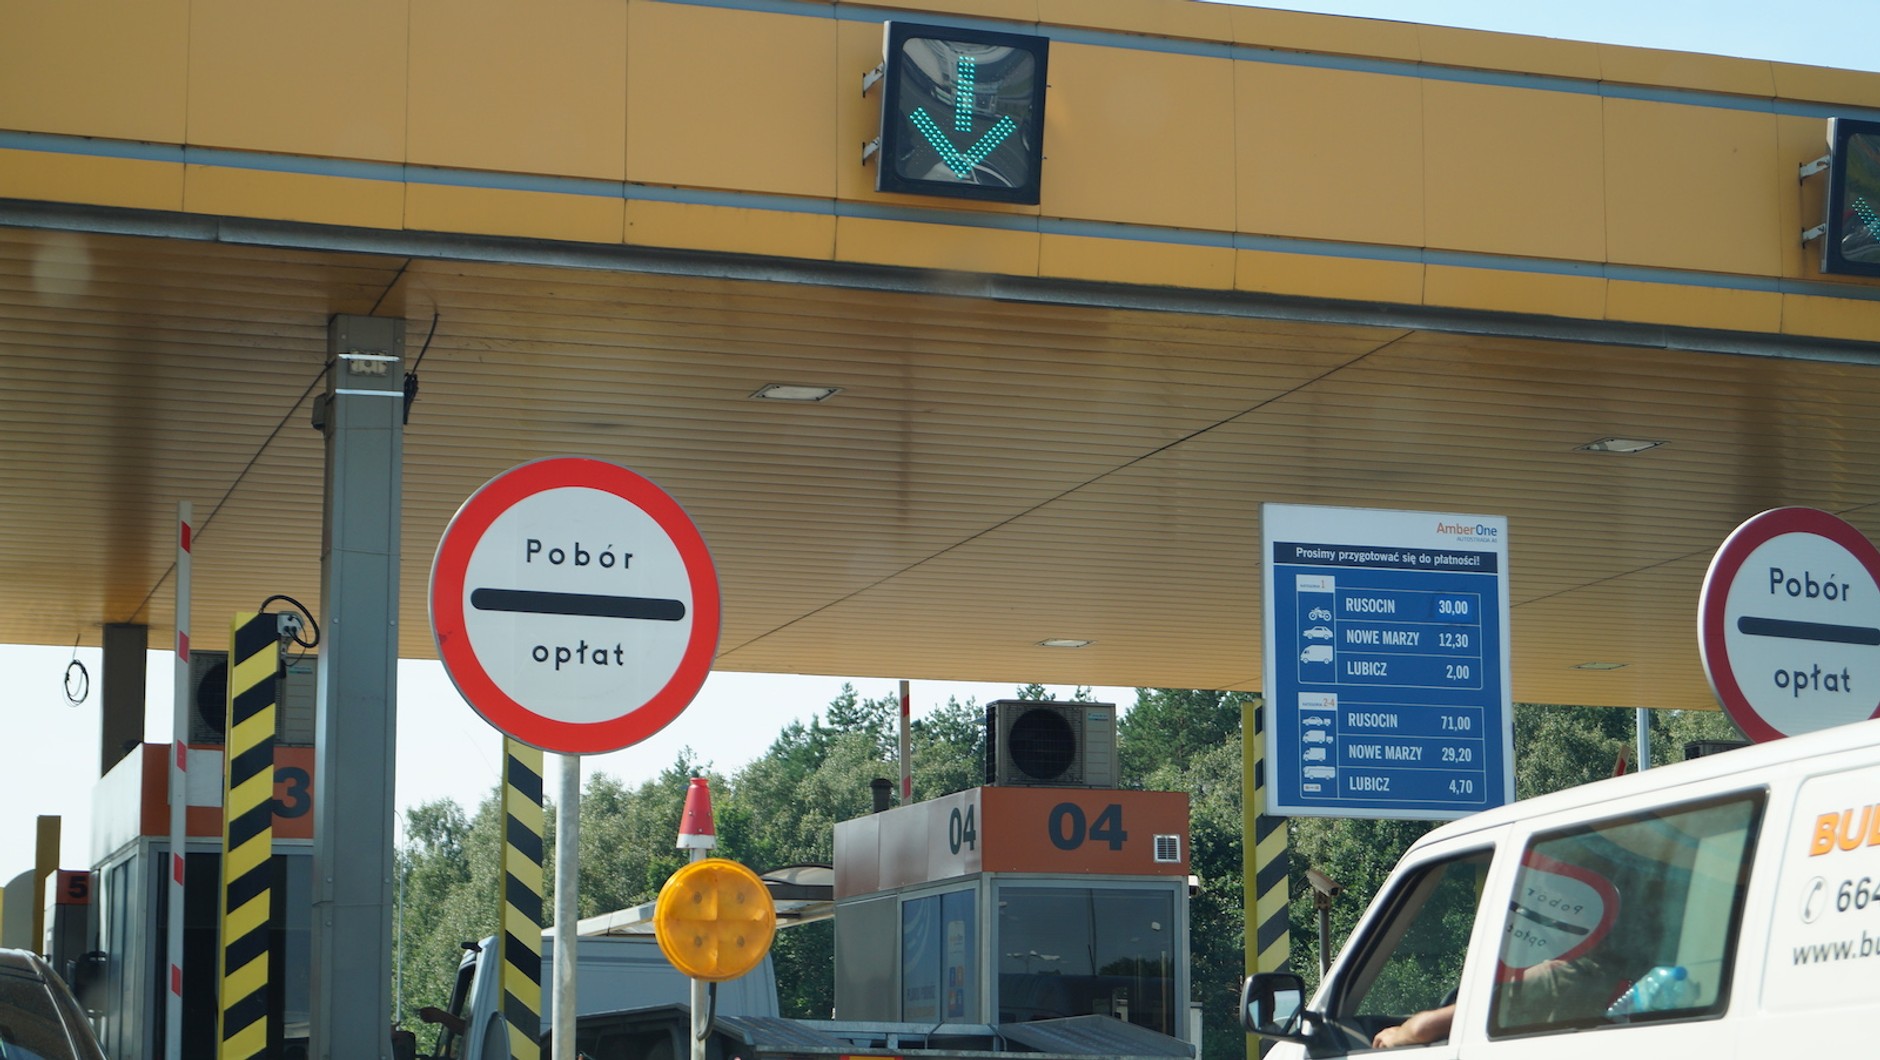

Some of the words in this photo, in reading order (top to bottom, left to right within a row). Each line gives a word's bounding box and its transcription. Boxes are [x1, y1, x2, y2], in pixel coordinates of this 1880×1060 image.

[1436, 521, 1498, 537] AmberOne
[526, 538, 633, 569] Pobór
[1296, 547, 1335, 561] Prosimy
[1338, 549, 1399, 563] przygotować
[1402, 552, 1416, 565] się
[1419, 553, 1431, 564] do
[1434, 553, 1481, 566] płatności!
[1769, 566, 1850, 602] Pobór
[1345, 597, 1396, 614] RUSOCIN
[1438, 599, 1468, 615] 30,00
[1346, 629, 1380, 645] NOWE
[1382, 631, 1420, 647] MARZY
[1438, 633, 1469, 649] 12,30
[531, 640, 624, 671] opłat
[1347, 661, 1388, 677] LUBICZ
[1446, 665, 1470, 681] 2,00
[1773, 663, 1851, 698] opłat
[1348, 712, 1398, 728] RUSOCIN
[1441, 715, 1471, 732] 71,00
[1348, 744, 1382, 760] NOWE
[1385, 746, 1423, 762] MARZY
[1441, 747, 1472, 763] 29,20
[1349, 776, 1390, 792] LUBICZ
[1449, 779, 1473, 795] 4,70
[949, 804, 976, 855] 04
[1048, 802, 1128, 851] 04
[68, 876, 88, 898] 5
